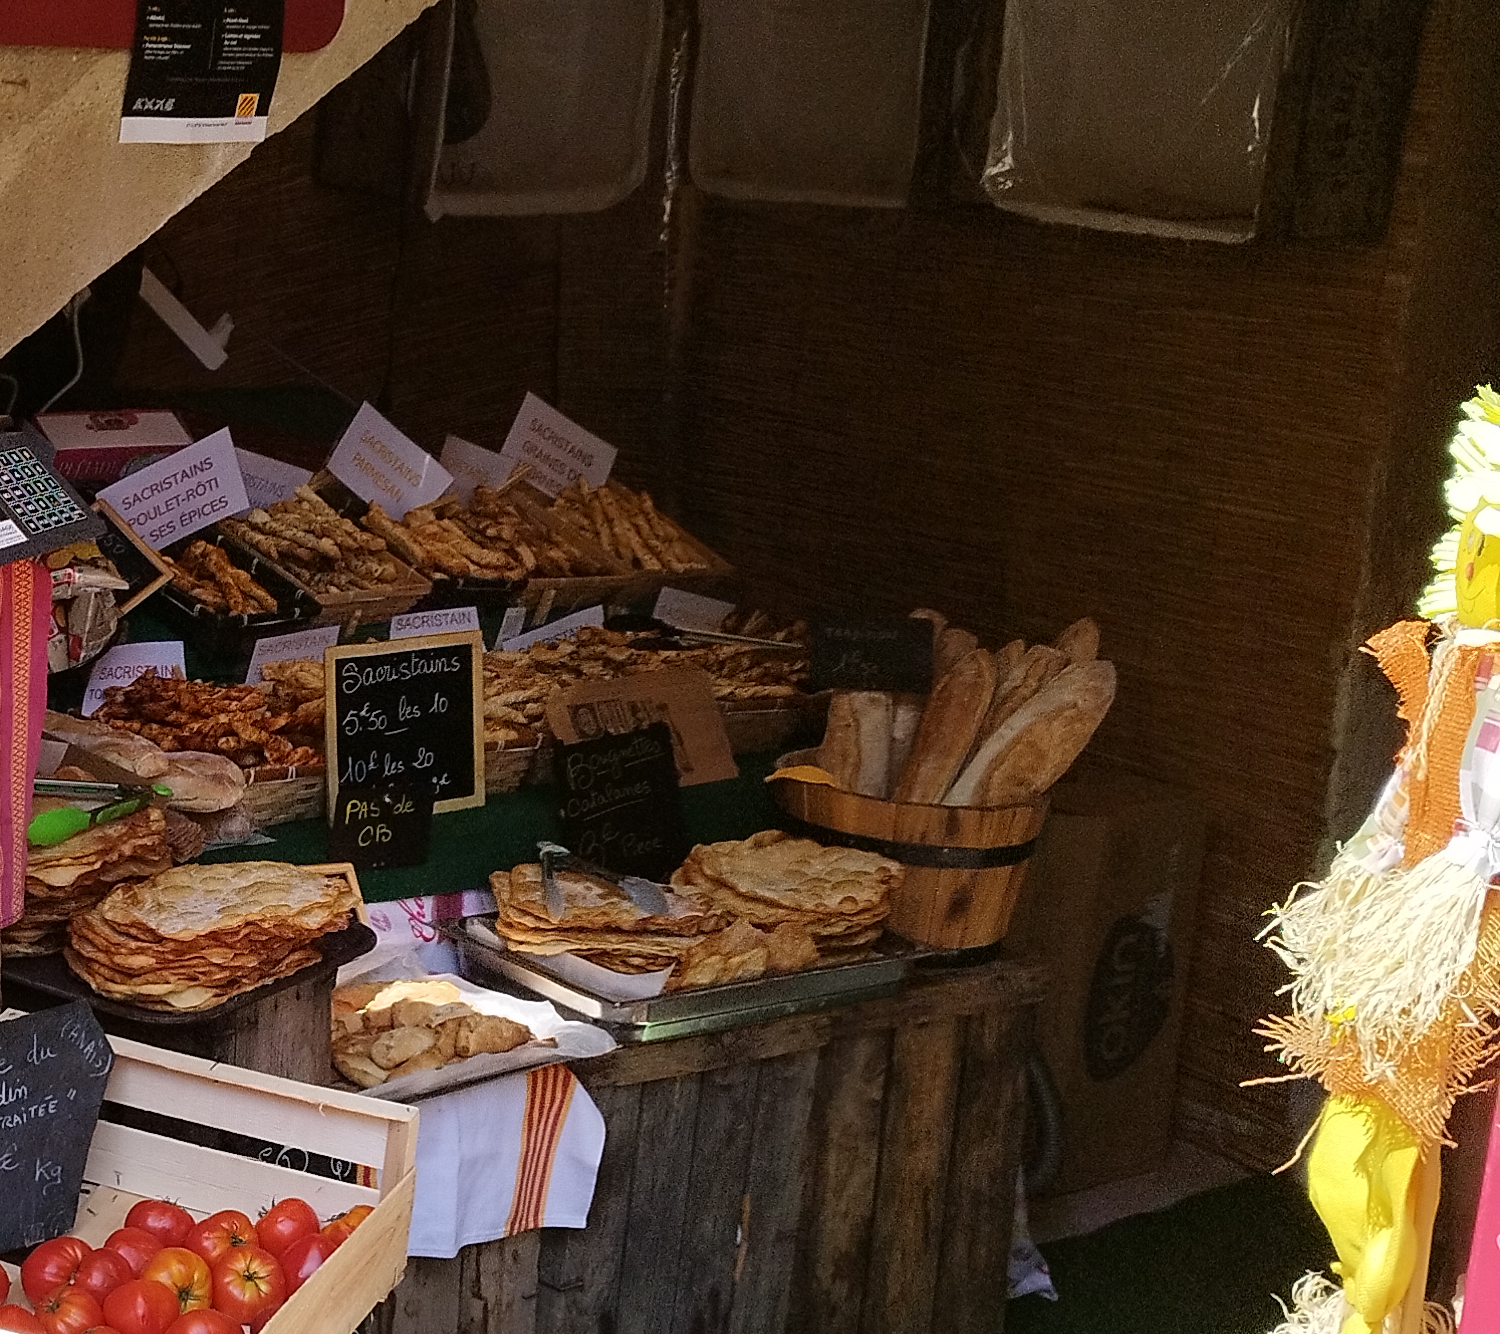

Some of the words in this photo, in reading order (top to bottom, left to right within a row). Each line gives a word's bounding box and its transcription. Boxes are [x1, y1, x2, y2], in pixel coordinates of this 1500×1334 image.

[121, 456, 215, 511] SACRISTAINS
[128, 476, 220, 527] POULET-RÔTI
[149, 521, 177, 544] SES
[180, 495, 229, 528] ÉPICES
[396, 612, 472, 631] SACRISTAIN
[342, 652, 461, 694] Sacristains
[398, 695, 421, 721] les
[428, 692, 449, 714] 10
[383, 753, 405, 777] les
[412, 747, 434, 769] 20
[345, 798, 380, 825] PAS
[393, 793, 416, 815] de
[357, 823, 393, 847] CB
[26, 1033, 57, 1065] du
